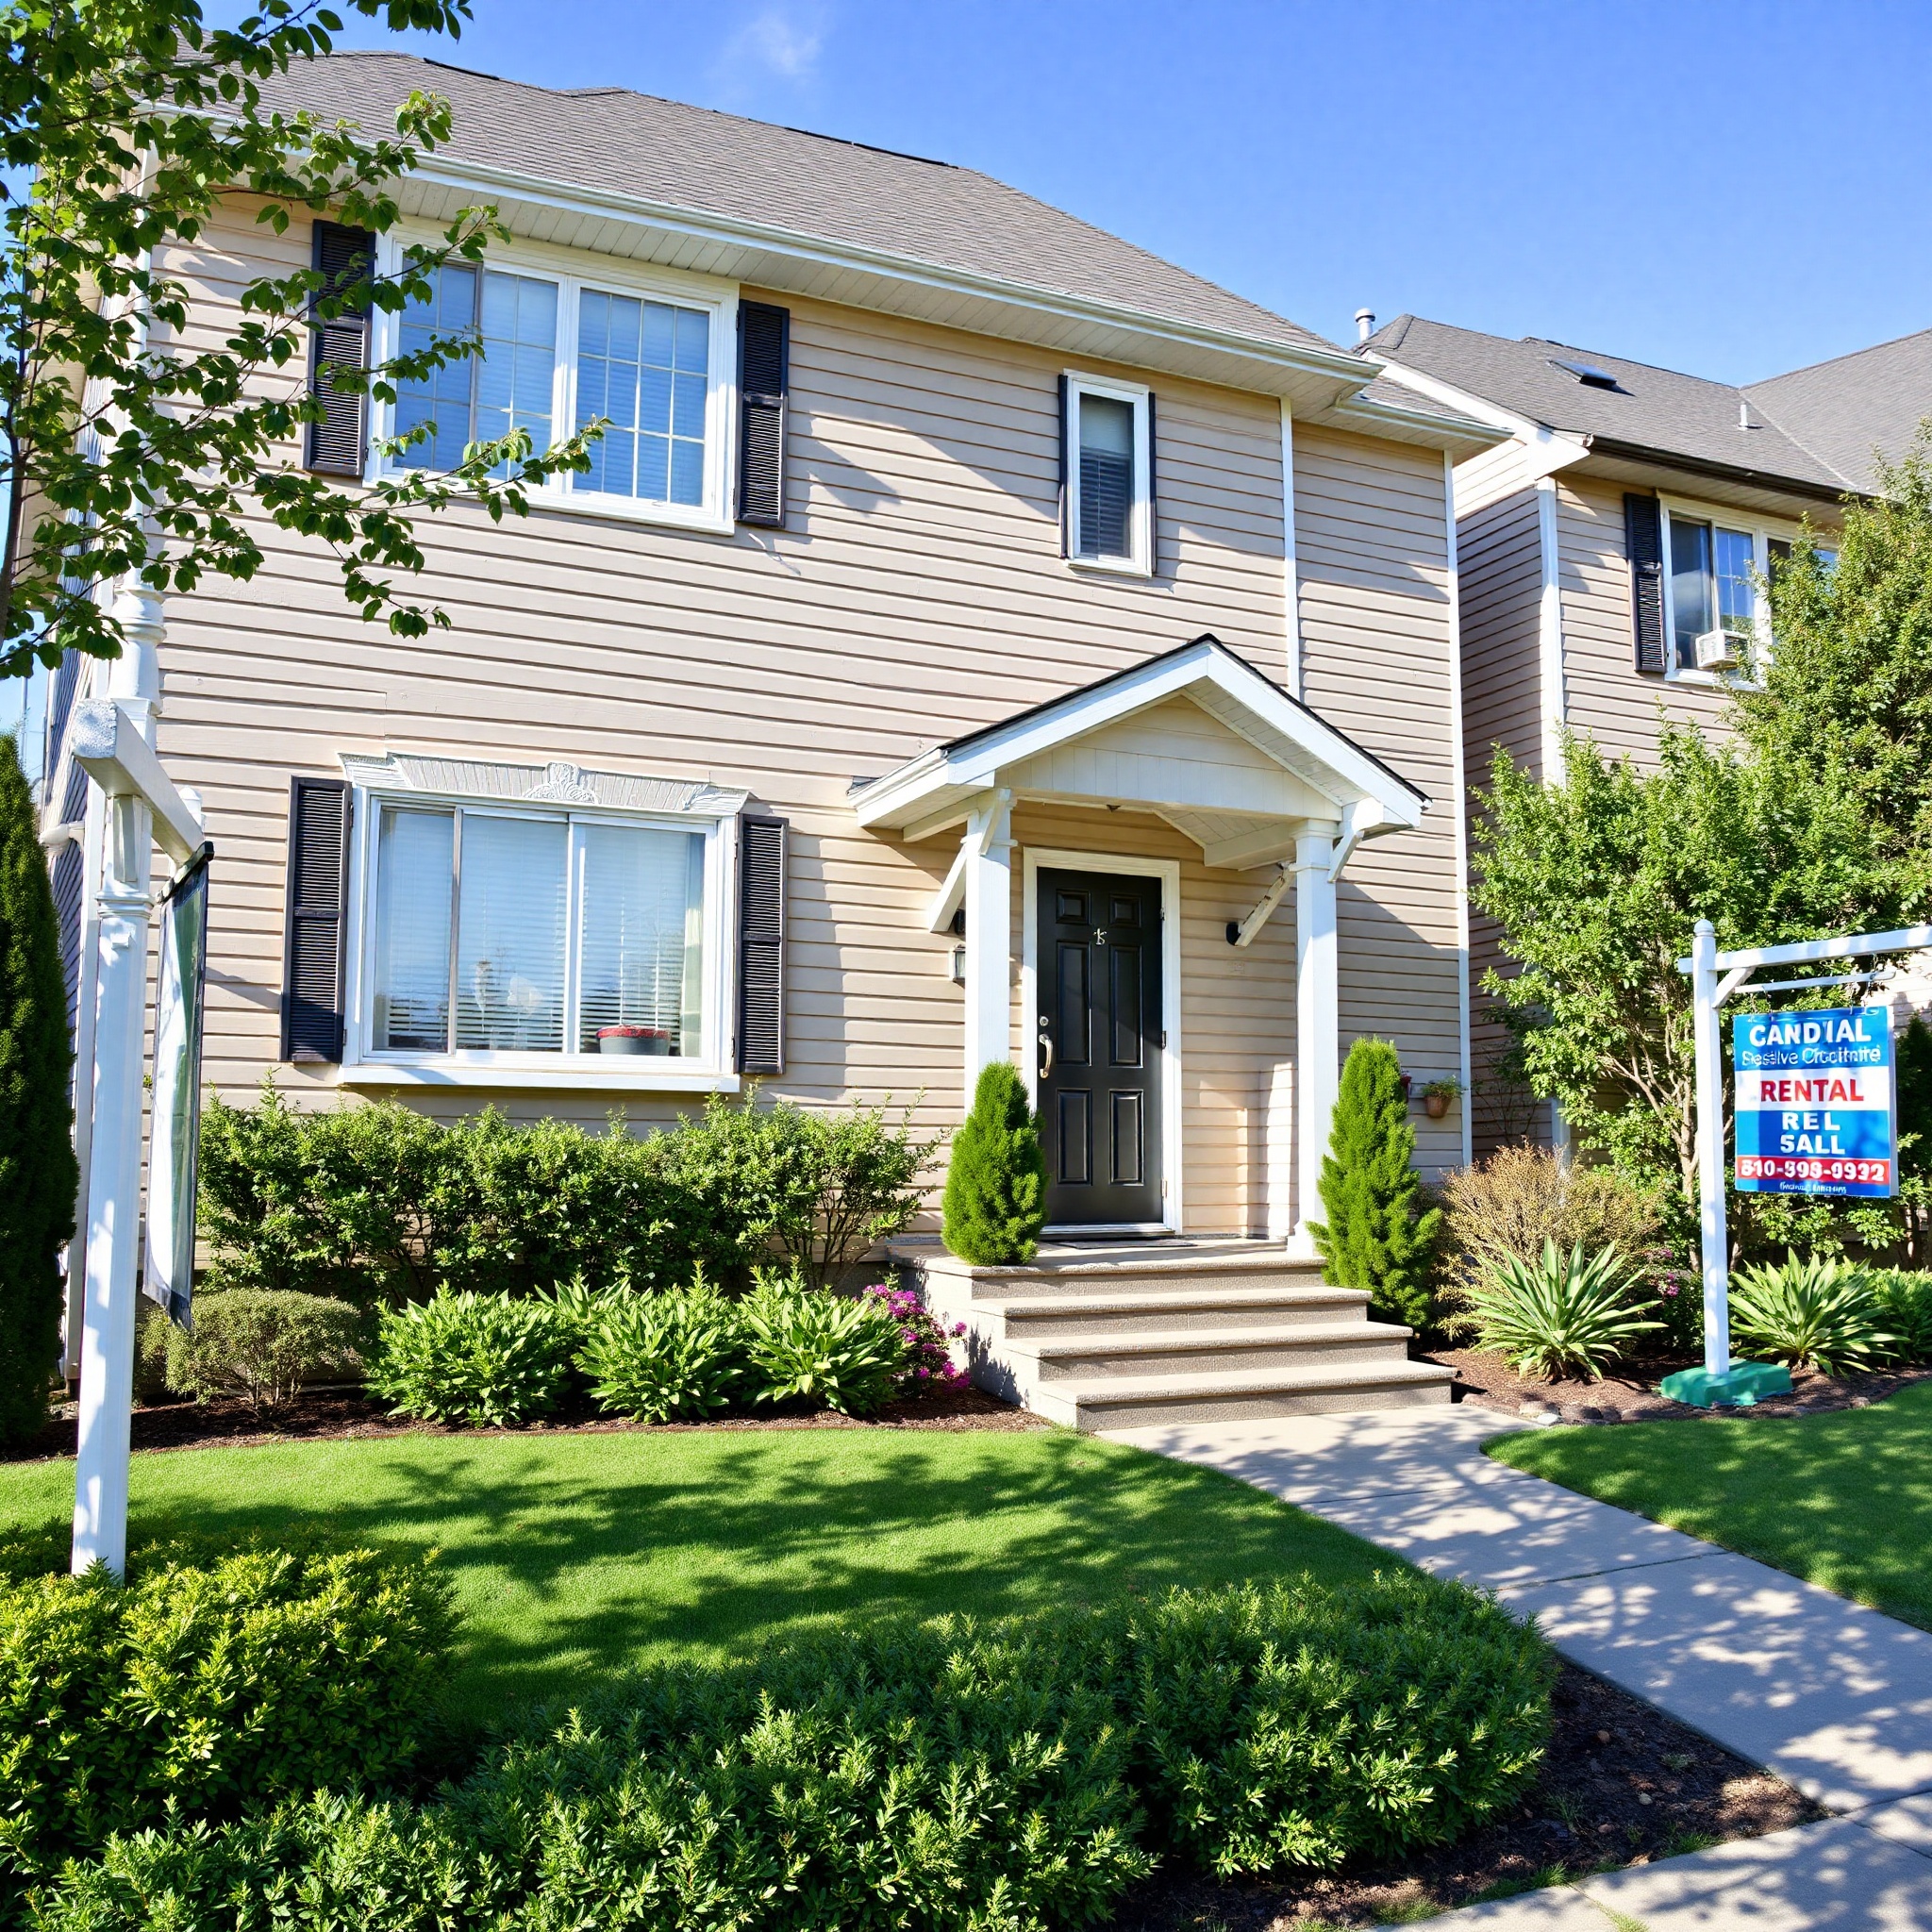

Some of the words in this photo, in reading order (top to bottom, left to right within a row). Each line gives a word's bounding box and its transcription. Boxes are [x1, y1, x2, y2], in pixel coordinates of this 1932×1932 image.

[1760, 1079, 1864, 1102] RENTAL
[1782, 1112, 1840, 1130] REL
[1780, 1134, 1845, 1155] SALL
